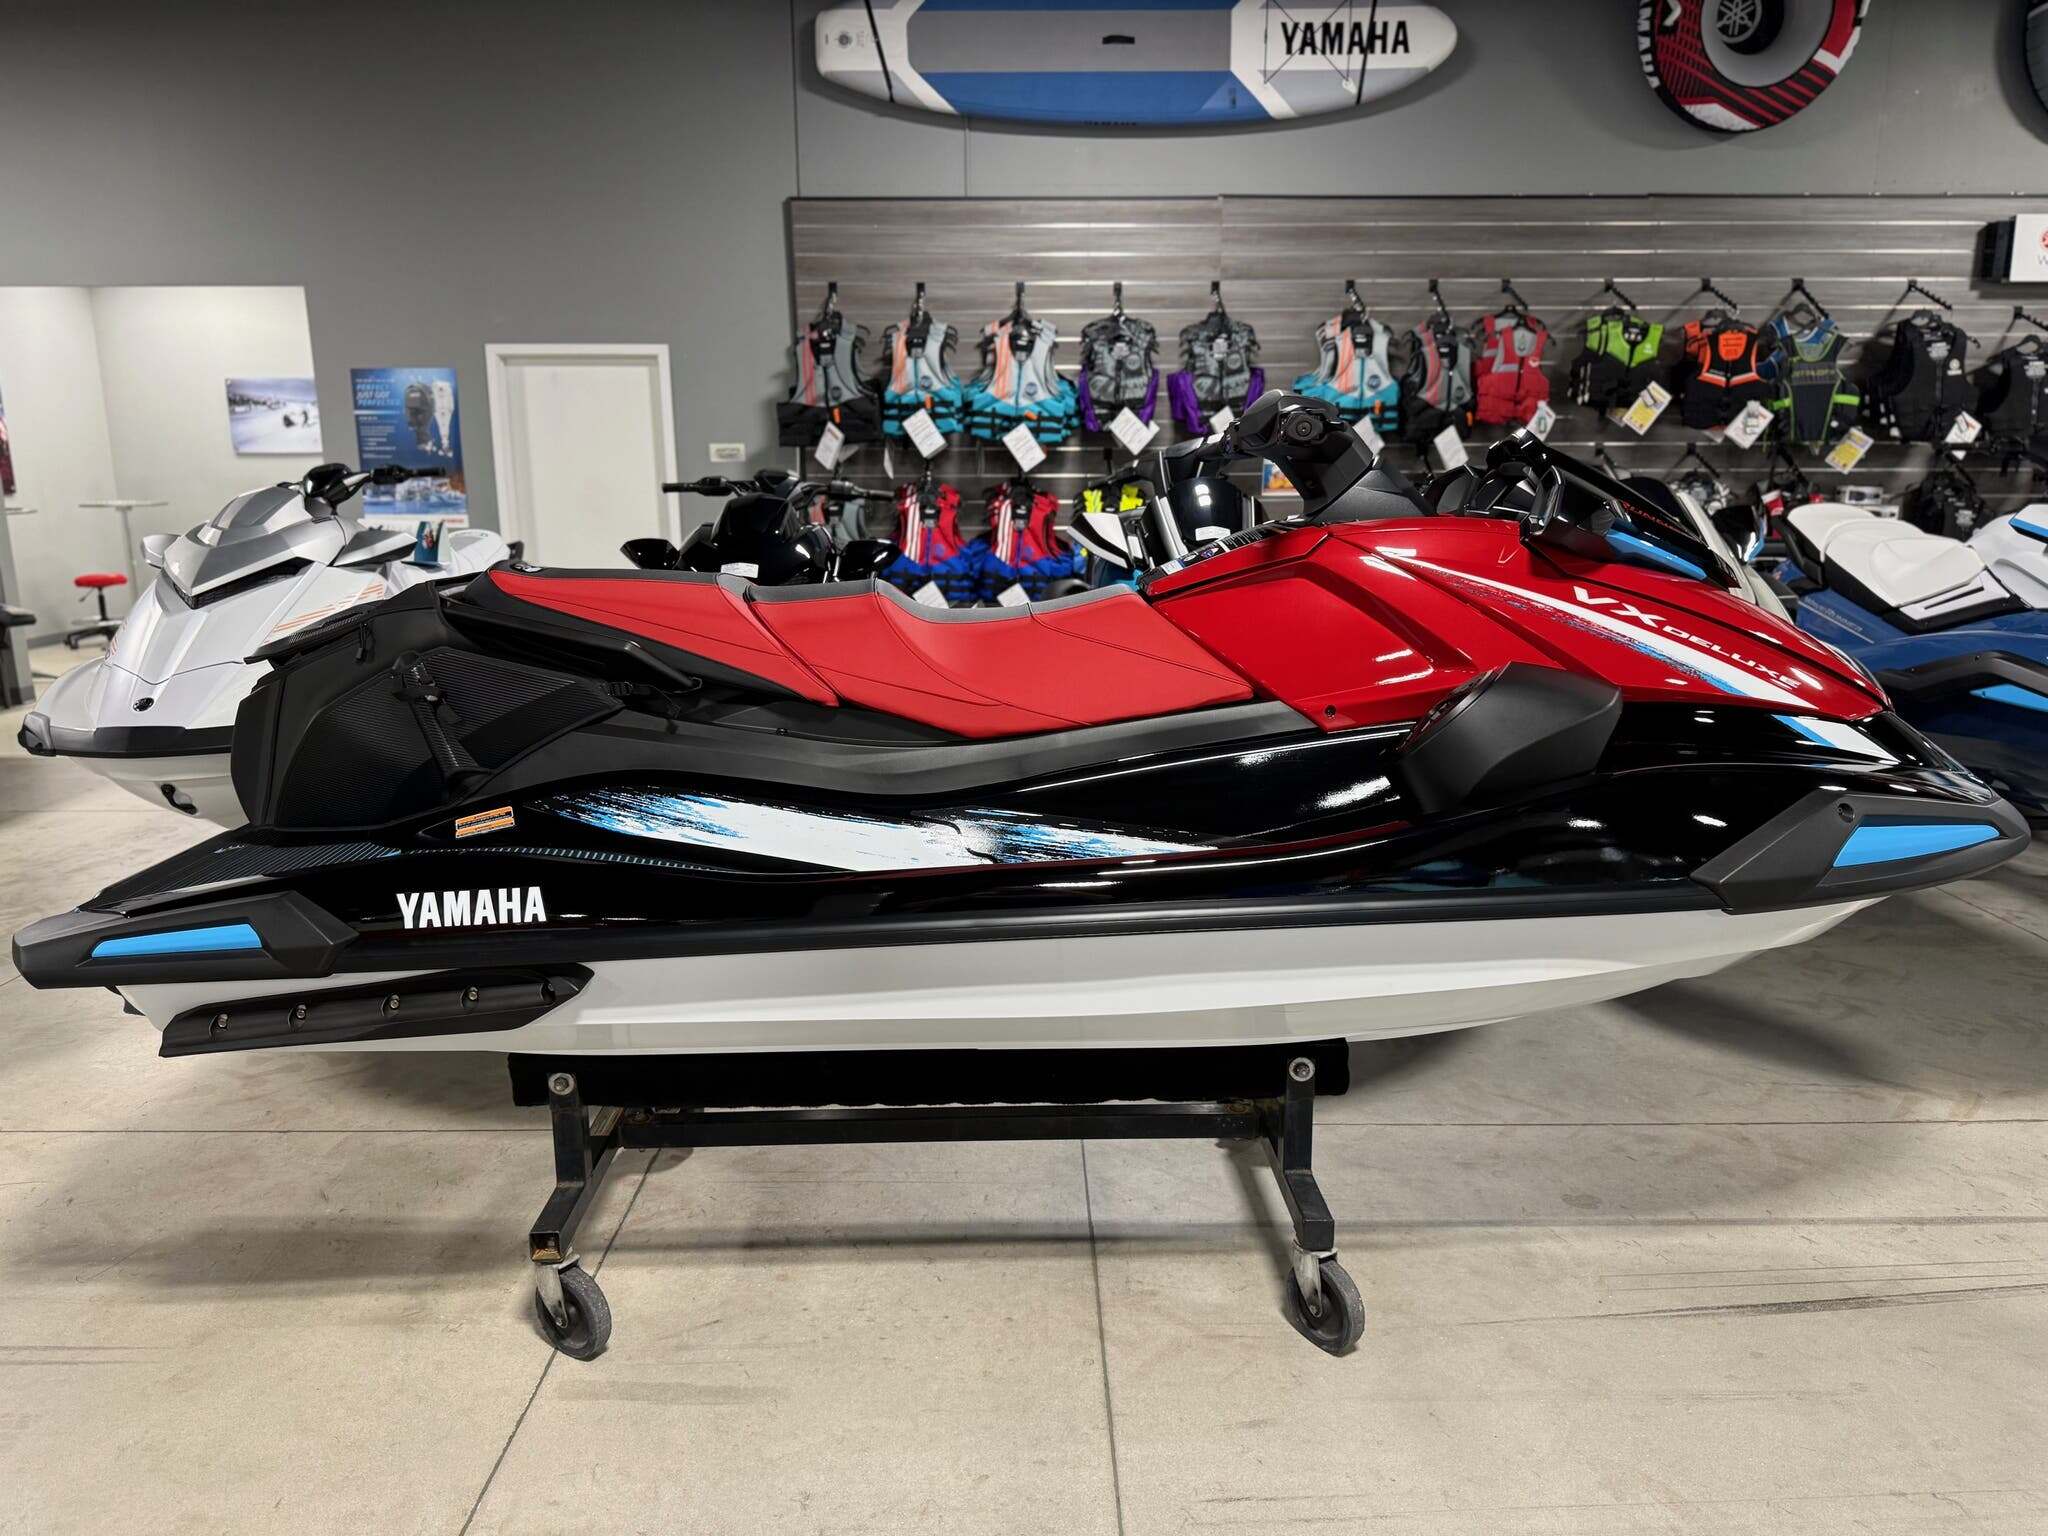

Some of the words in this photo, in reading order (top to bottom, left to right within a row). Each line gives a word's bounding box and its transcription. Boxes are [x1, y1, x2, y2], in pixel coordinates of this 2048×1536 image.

[1281, 20, 1410, 55] YAMAHA
[1573, 586, 1666, 628] VX
[1662, 626, 1801, 690] DELUXE
[396, 886, 547, 929] YAMAHA
